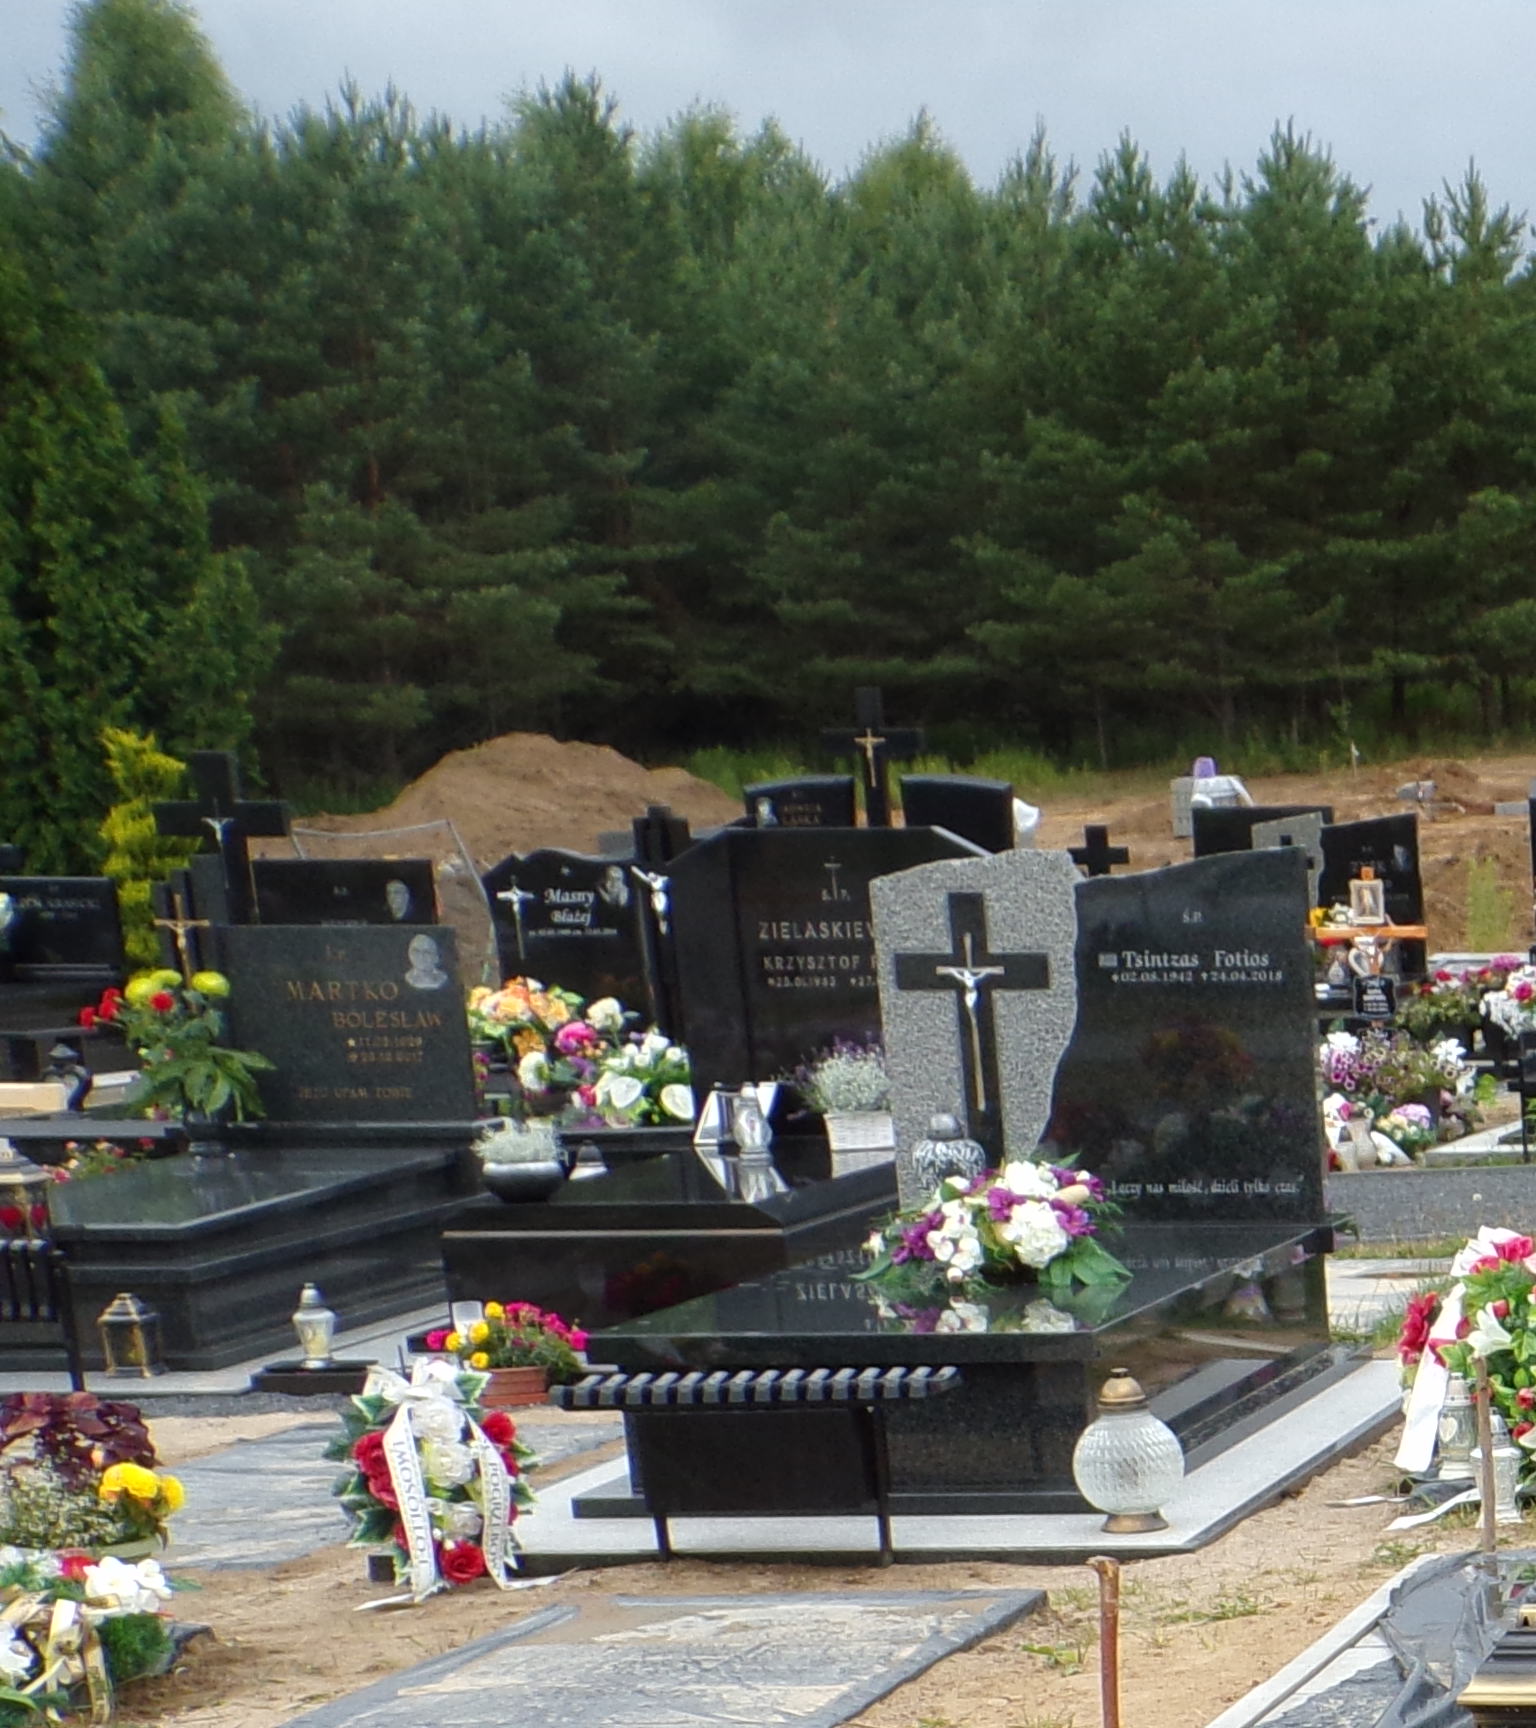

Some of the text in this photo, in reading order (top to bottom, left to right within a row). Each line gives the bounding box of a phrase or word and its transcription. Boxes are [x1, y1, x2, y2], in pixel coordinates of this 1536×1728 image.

[763, 955, 861, 971] KRZYSZTOF
[1121, 948, 1271, 968] Tsintzas Fotios
[286, 980, 400, 1001] MARTKO
